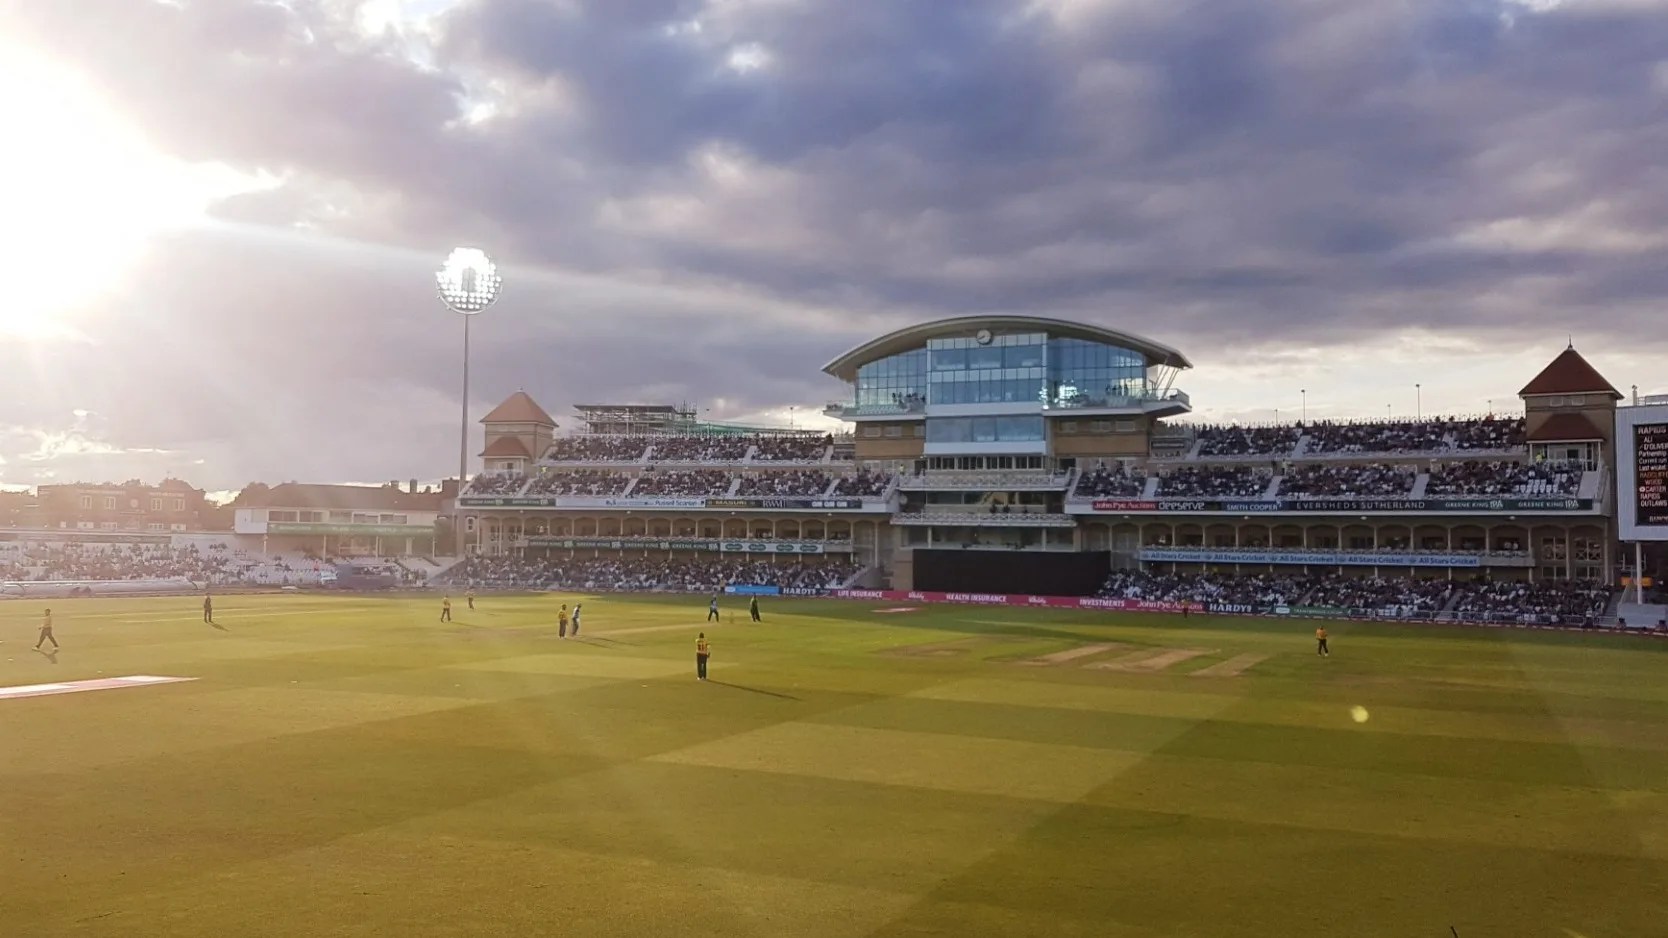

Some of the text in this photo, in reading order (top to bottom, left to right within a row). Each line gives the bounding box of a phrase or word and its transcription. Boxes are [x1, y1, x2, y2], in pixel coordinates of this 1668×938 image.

[1226, 503, 1278, 511] SMITH COOPER
[1296, 501, 1425, 510] EVERSHEDS SUTHERLAND
[783, 587, 816, 595] HARDYS
[850, 590, 883, 598] INSURANCE
[946, 593, 1007, 602] HEALTH INSURANCE
[1080, 598, 1124, 607] INVESTMENTS
[1137, 600, 1156, 608] John
[1210, 603, 1252, 612] HARDYS
